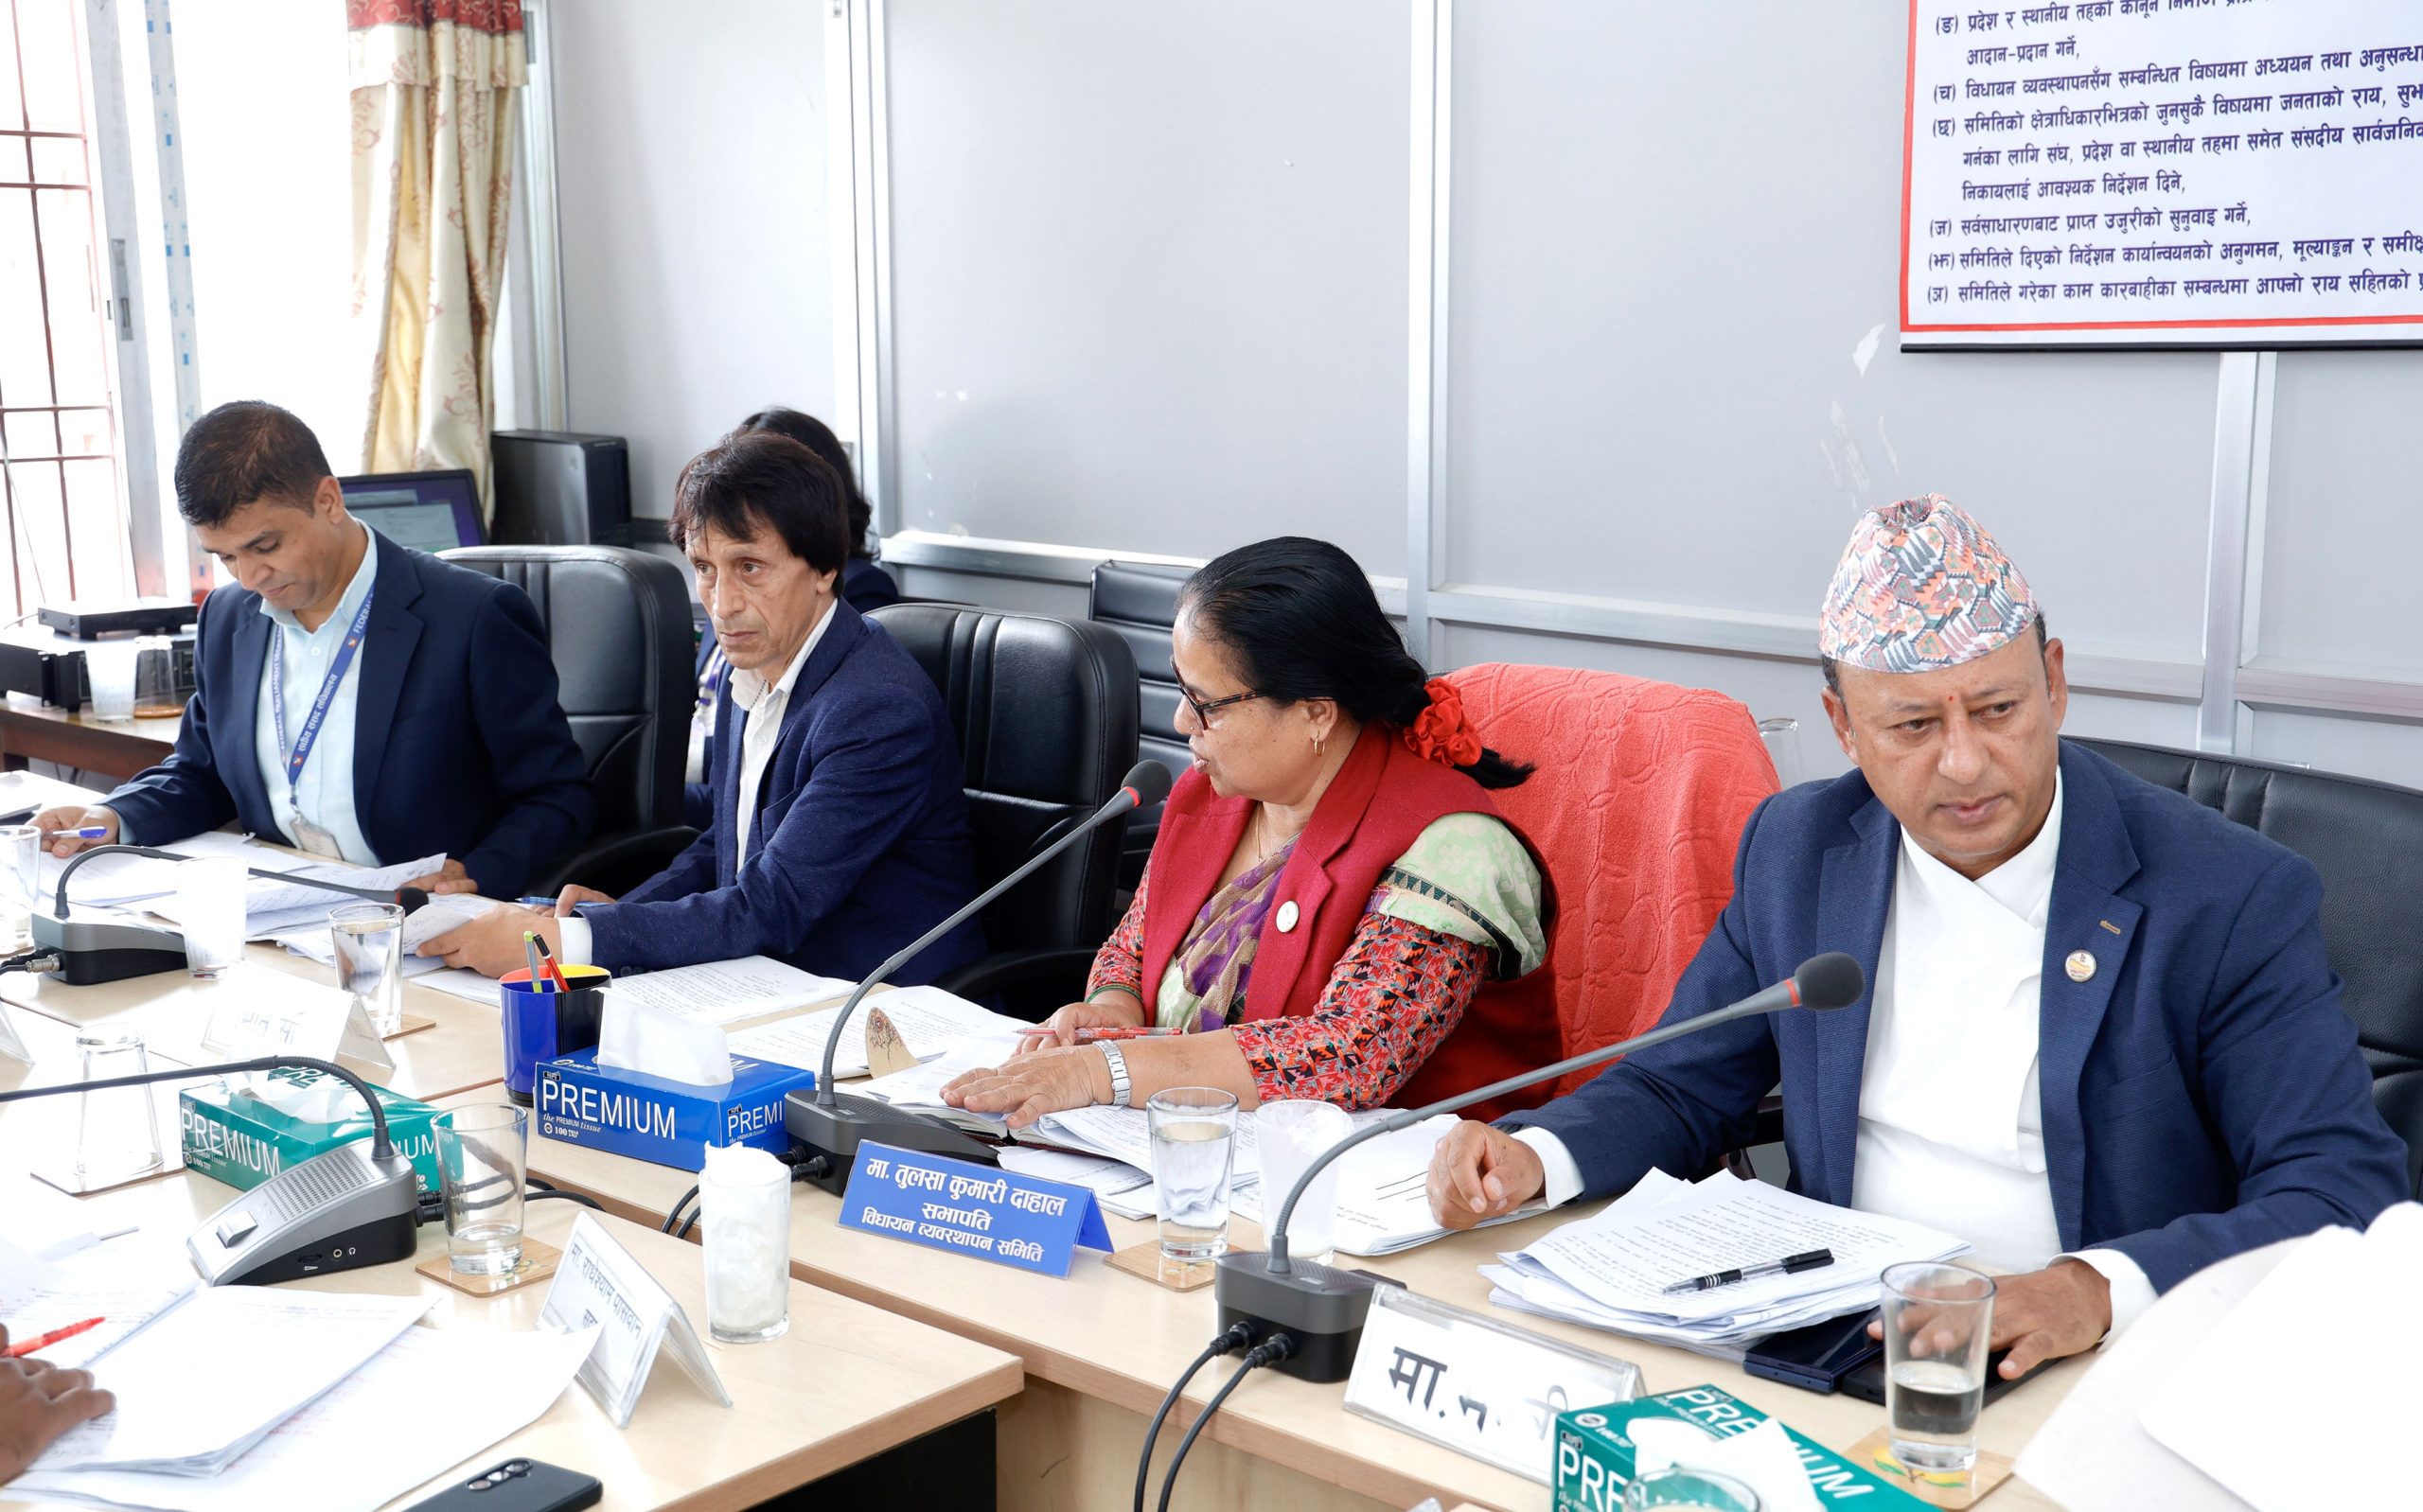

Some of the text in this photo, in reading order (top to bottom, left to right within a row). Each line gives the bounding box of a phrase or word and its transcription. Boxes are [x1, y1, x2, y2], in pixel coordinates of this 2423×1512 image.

[1968, 10, 1998, 32] प्रदेश
[2006, 11, 2015, 29] र
[2022, 2, 2069, 26] स्थानीय
[1934, 84, 1955, 102] (च)
[1966, 79, 2016, 98] विधायन
[2118, 62, 2181, 89] सम्बन्धित
[2188, 60, 2248, 80] विषयमा
[2255, 56, 2312, 76] अध्ययन
[2321, 52, 2351, 72] तथा
[1933, 117, 1955, 138] (छ)
[1965, 111, 2025, 134] समितिको
[2156, 95, 2205, 125] जुनसुकै
[2213, 94, 2273, 115] विषयमा
[2280, 86, 2343, 110] जनताको
[2351, 87, 2386, 108] राय,
[1963, 147, 2001, 167] गर्नका
[2008, 143, 2040, 166] लागि
[2082, 140, 2113, 162] प्रदेश
[2120, 141, 2136, 157] वा
[2144, 134, 2194, 155] स्थानीय
[2202, 135, 2239, 154] तहमा
[2248, 129, 2283, 150] समेत
[2291, 123, 2344, 149] संसदीय
[1962, 178, 2030, 201] निकायलाई
[2038, 179, 2096, 198] आवश्यक
[2103, 173, 2149, 196] निर्देशन
[1930, 220, 1952, 237] (ज)
[1961, 215, 2060, 236] सर्वसाधारणबाट
[2066, 214, 2097, 232] प्राप्त
[2105, 207, 2162, 234] उजुरीको
[1959, 247, 2013, 268] समितिले
[2020, 246, 2062, 270] दिएको
[2070, 243, 2115, 266] निर्देशन
[2123, 240, 2212, 262] कार्यान्वयनको
[2362, 237, 2375, 256] र
[1958, 280, 2012, 302] समितिले
[2019, 281, 2057, 302] गरेका
[2063, 283, 2094, 299] काम
[2100, 276, 2176, 300] कारबाहीका
[2184, 278, 2249, 297] सम्बन्धमा
[2311, 276, 2341, 295] राय
[2349, 269, 2411, 292] सहितको
[542, 1079, 676, 1140] PREMIUM
[543, 1113, 556, 1122] the
[580, 1120, 602, 1133] tissue
[727, 1100, 783, 1137] PREMI
[182, 1108, 280, 1176] PREMIUM
[555, 1126, 567, 1136] 100
[866, 1158, 1067, 1217] मा. तुलसा कुमारी दाहाल
[922, 1202, 993, 1231] सभापति
[917, 1222, 995, 1251] व्यवस्थापन
[997, 1239, 1044, 1263] समिति
[1388, 1345, 1448, 1418] मा.
